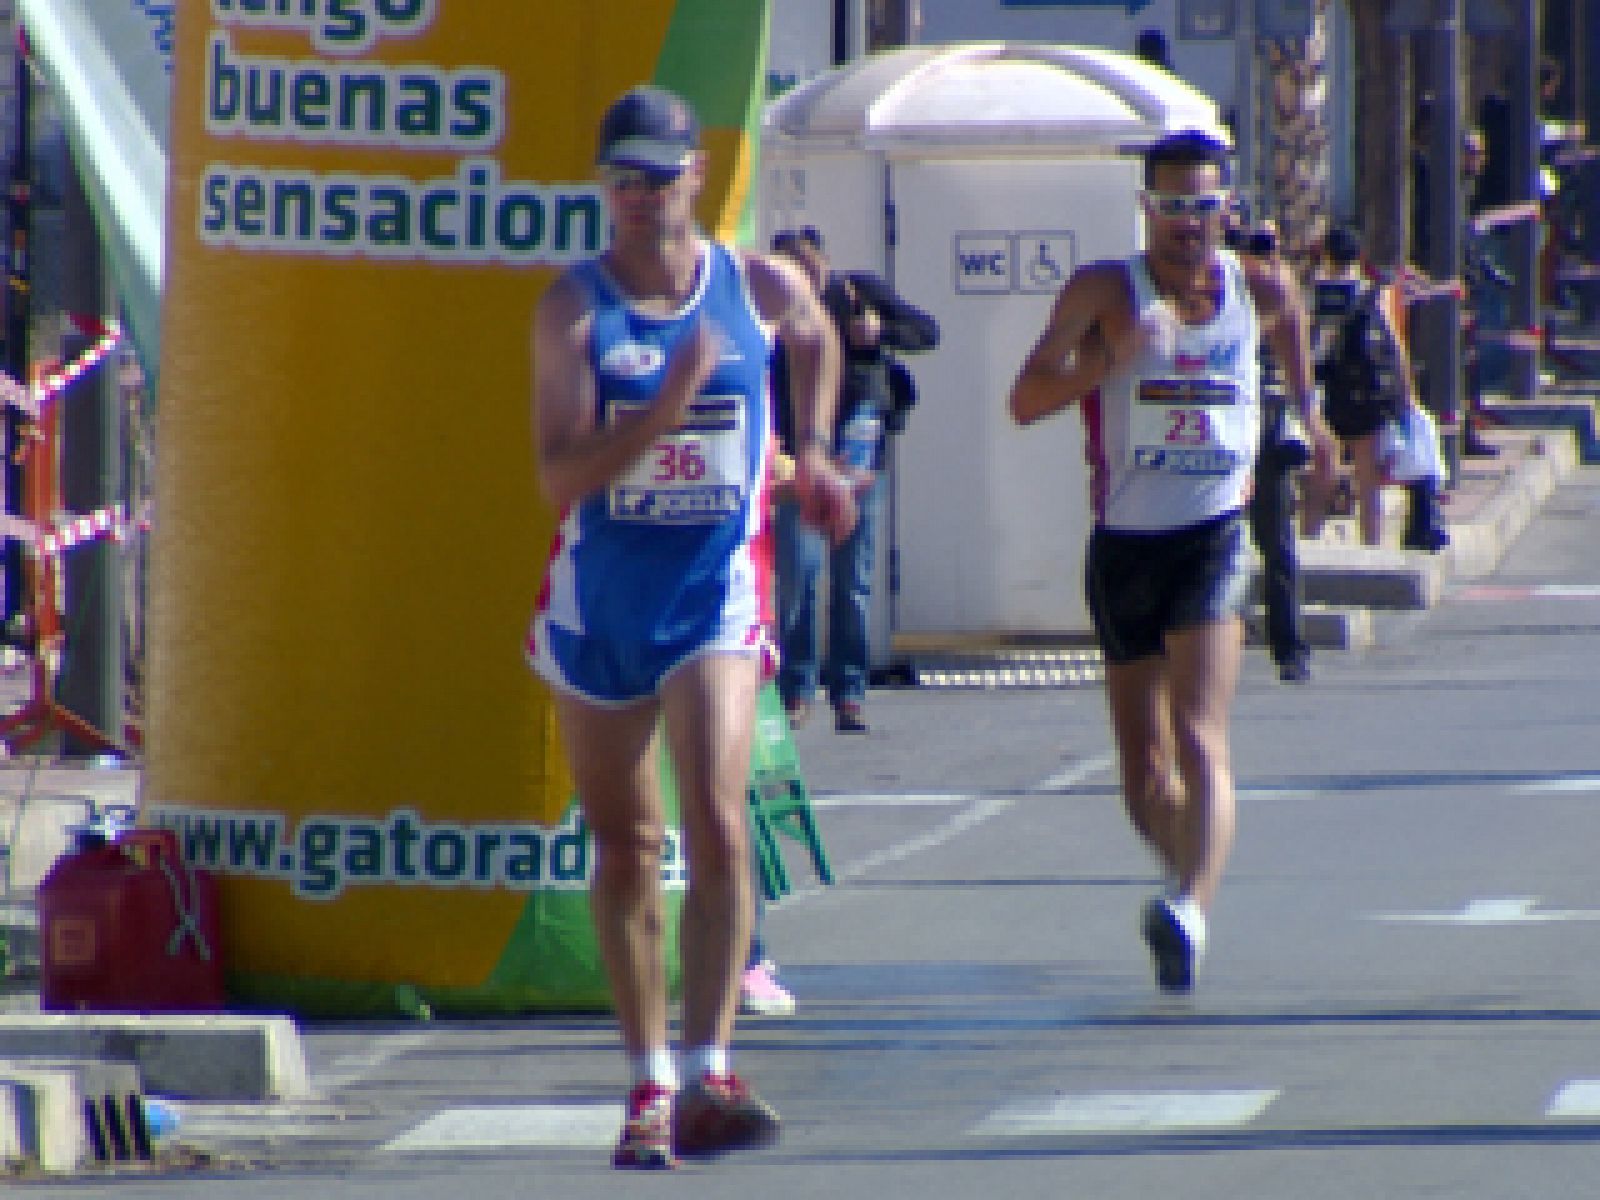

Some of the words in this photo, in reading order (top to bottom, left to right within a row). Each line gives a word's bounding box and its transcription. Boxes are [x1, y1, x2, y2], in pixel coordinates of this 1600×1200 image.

[209, 40, 492, 138] buenas
[204, 168, 615, 250] sensacion
[959, 254, 1006, 275] WC
[1164, 409, 1211, 445] 23
[654, 443, 706, 481] 36
[152, 810, 687, 892] ww.gatorad
